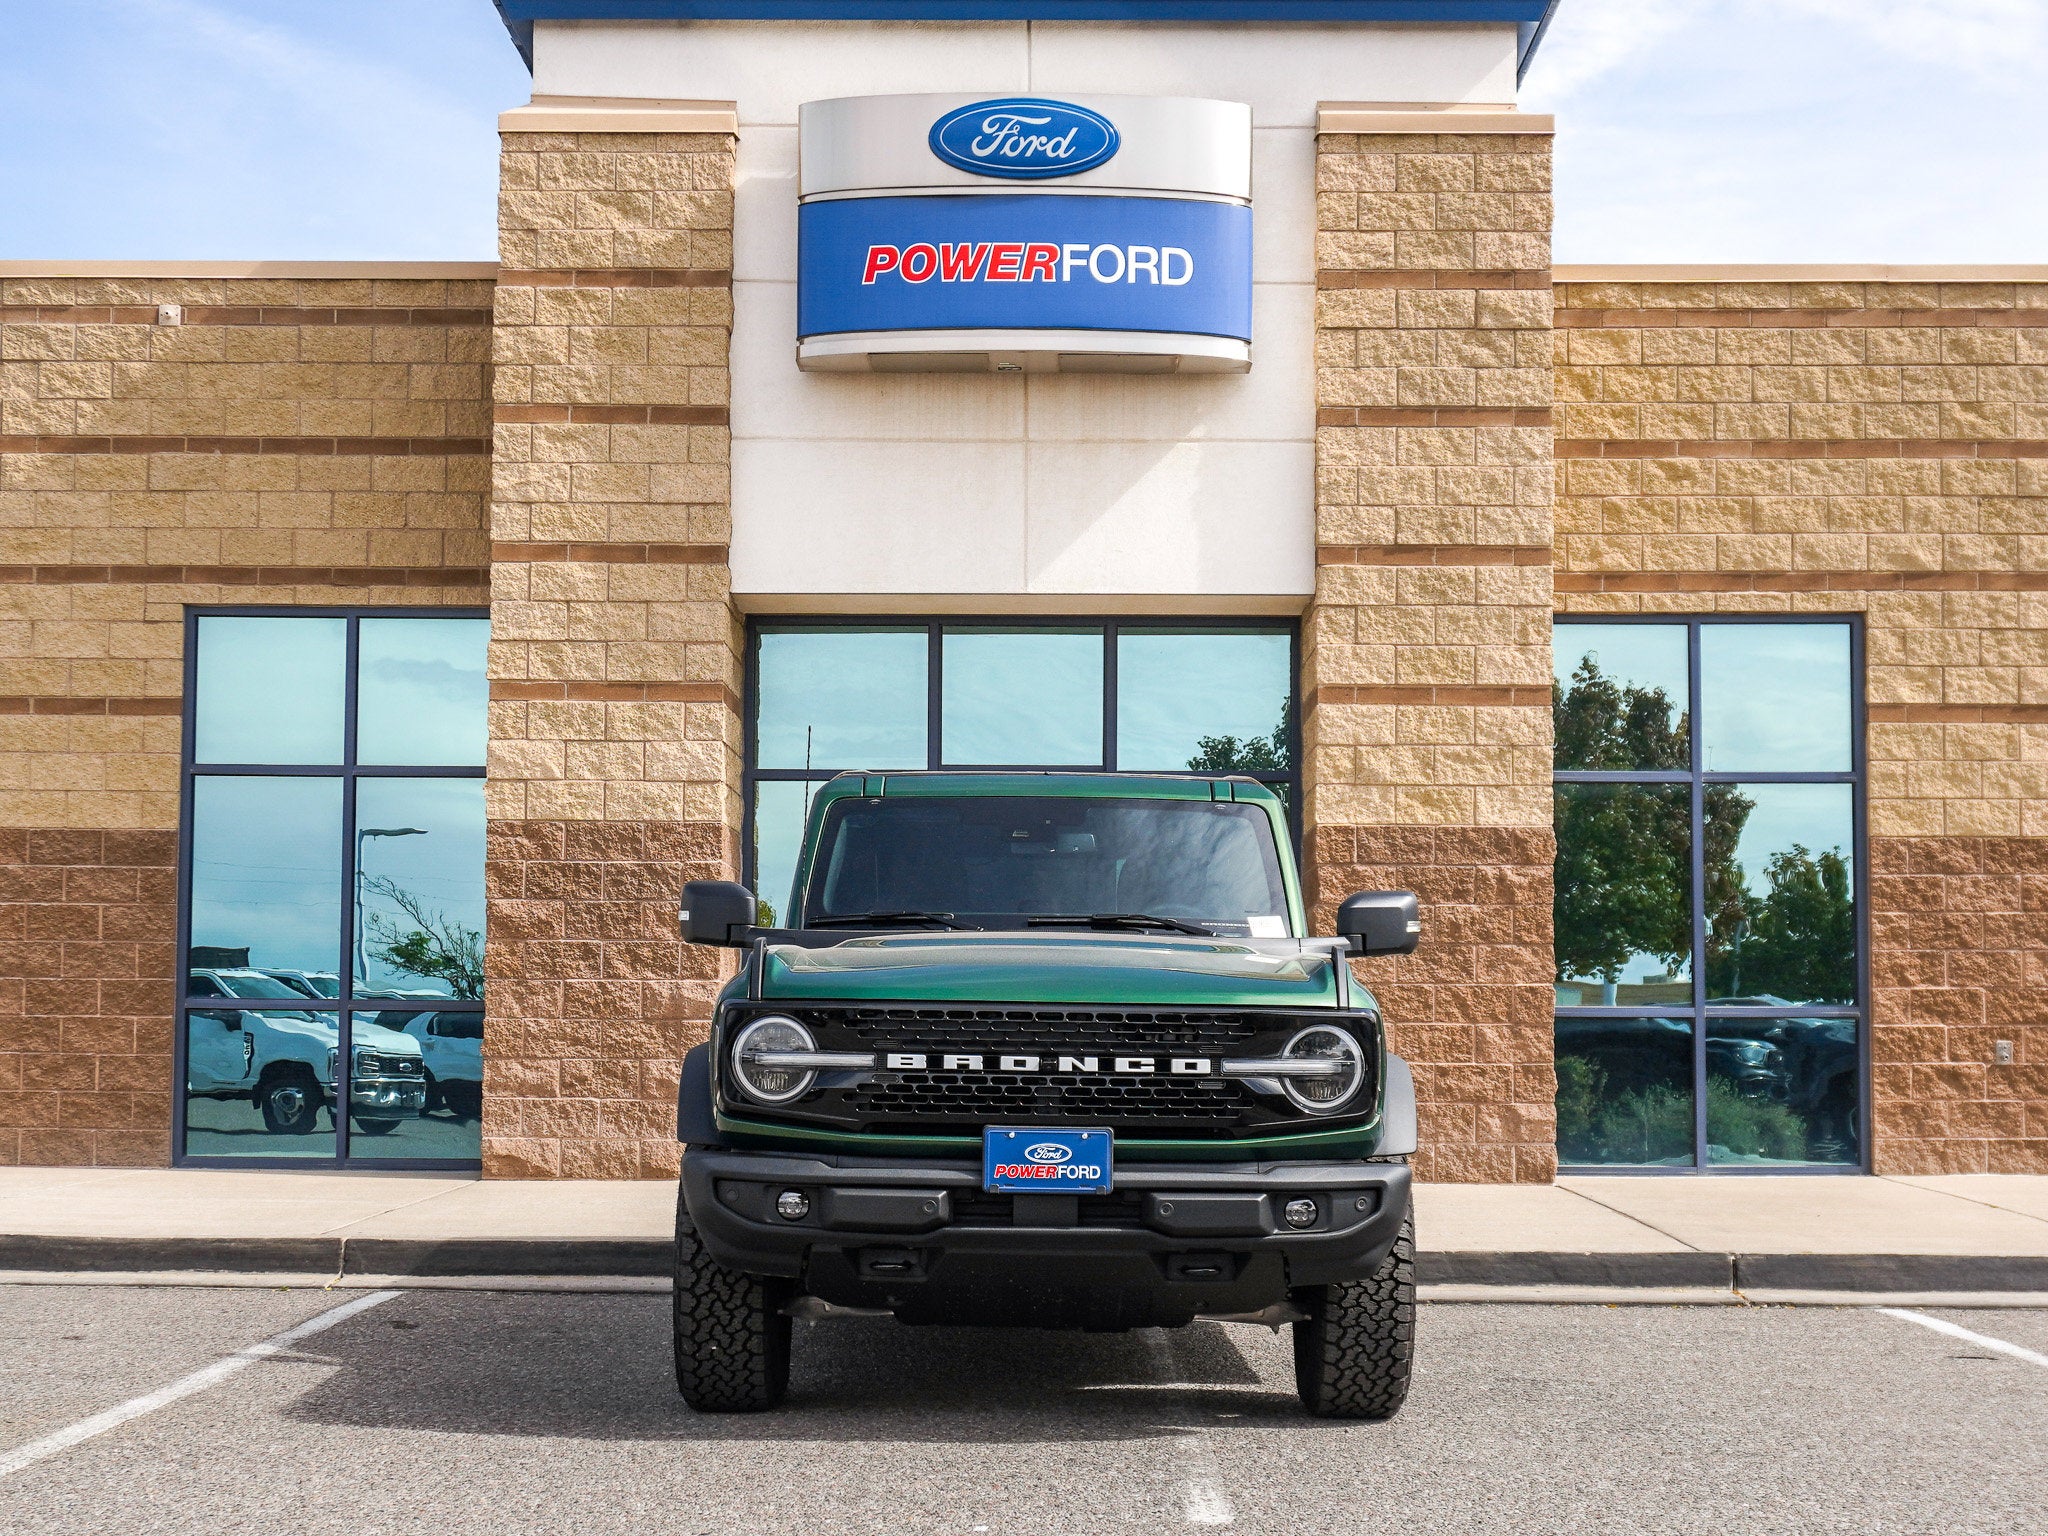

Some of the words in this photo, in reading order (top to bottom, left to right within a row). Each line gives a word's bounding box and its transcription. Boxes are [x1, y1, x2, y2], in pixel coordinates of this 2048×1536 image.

[971, 113, 1079, 159] Ford
[861, 242, 1194, 286] POWERFORD
[887, 1053, 1211, 1074] BRONCO
[1033, 1146, 1062, 1160] Ford
[994, 1164, 1101, 1179] POWERFORD
